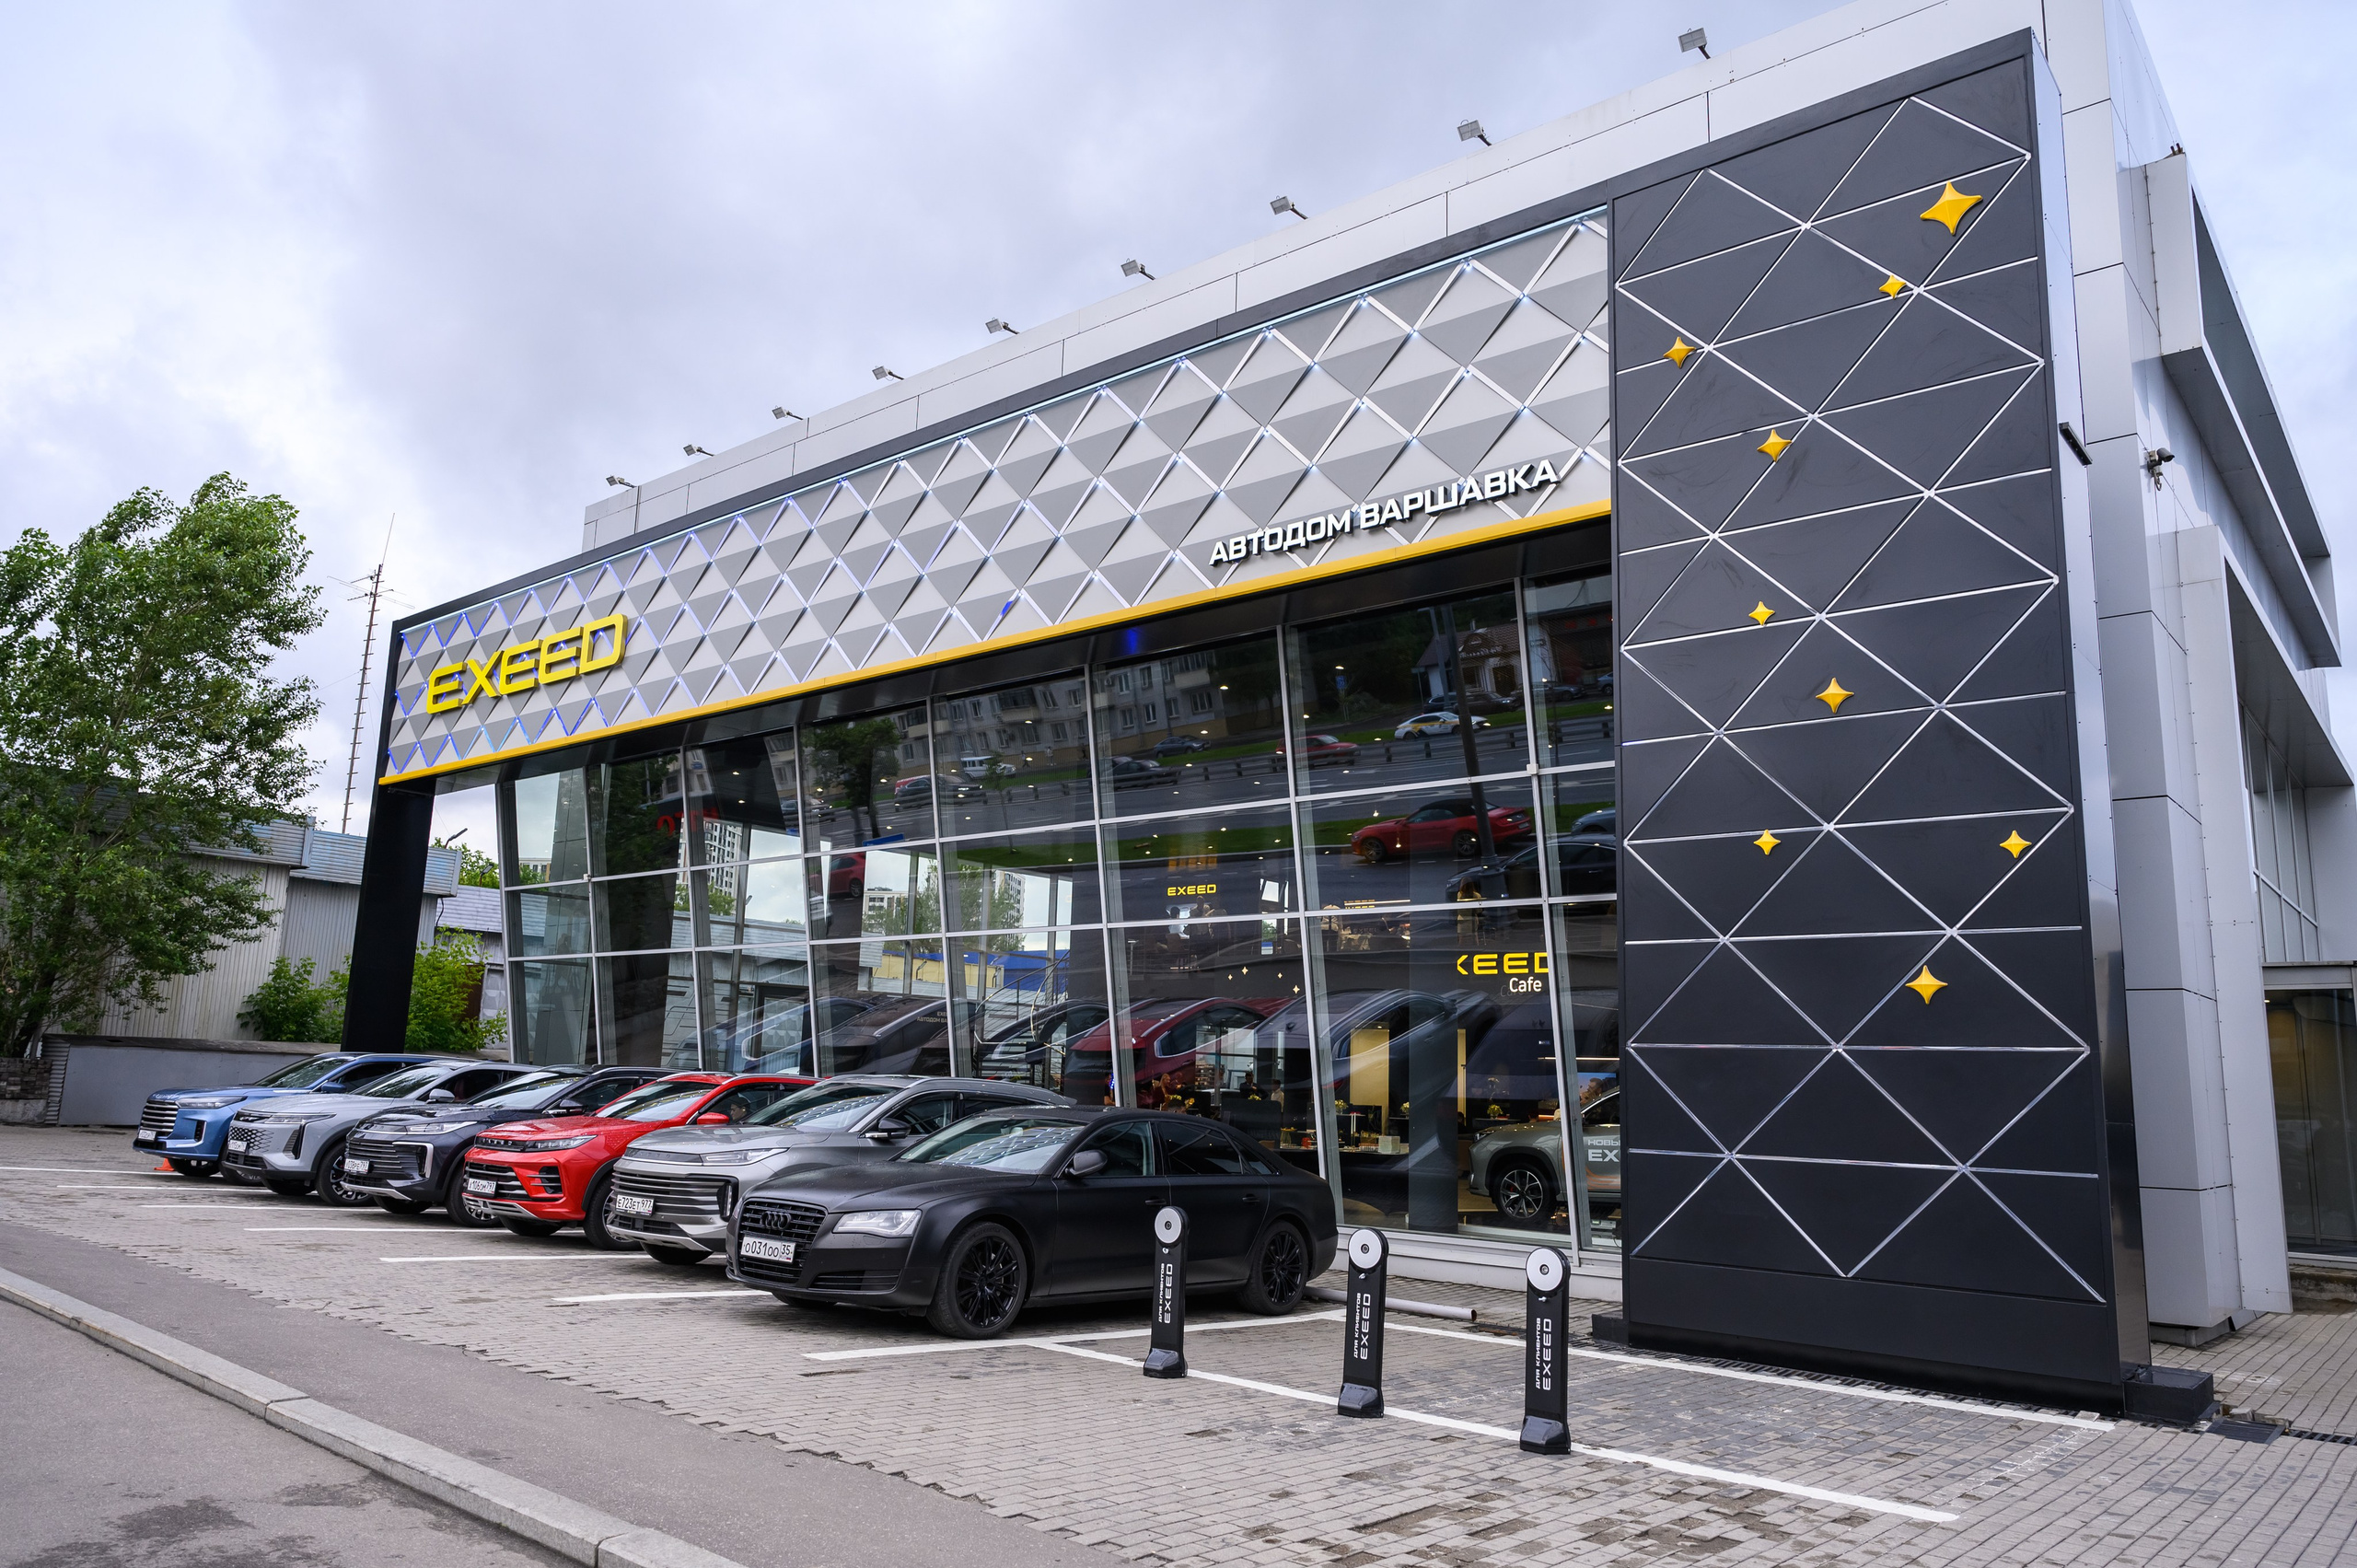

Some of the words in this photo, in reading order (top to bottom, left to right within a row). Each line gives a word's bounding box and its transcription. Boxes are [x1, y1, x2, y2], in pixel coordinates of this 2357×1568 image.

[1208, 509, 1354, 566] АВТОДОМ
[1359, 459, 1562, 531] ВАРШАВКА
[426, 613, 628, 714] EXEED
[1167, 884, 1217, 897] EXEED
[1509, 976, 1542, 993] Cafe
[1587, 1148, 1620, 1162] EX
[1164, 1263, 1173, 1324] EXEED
[1360, 1293, 1371, 1360] EXEED
[1542, 1318, 1551, 1391] EXEED
